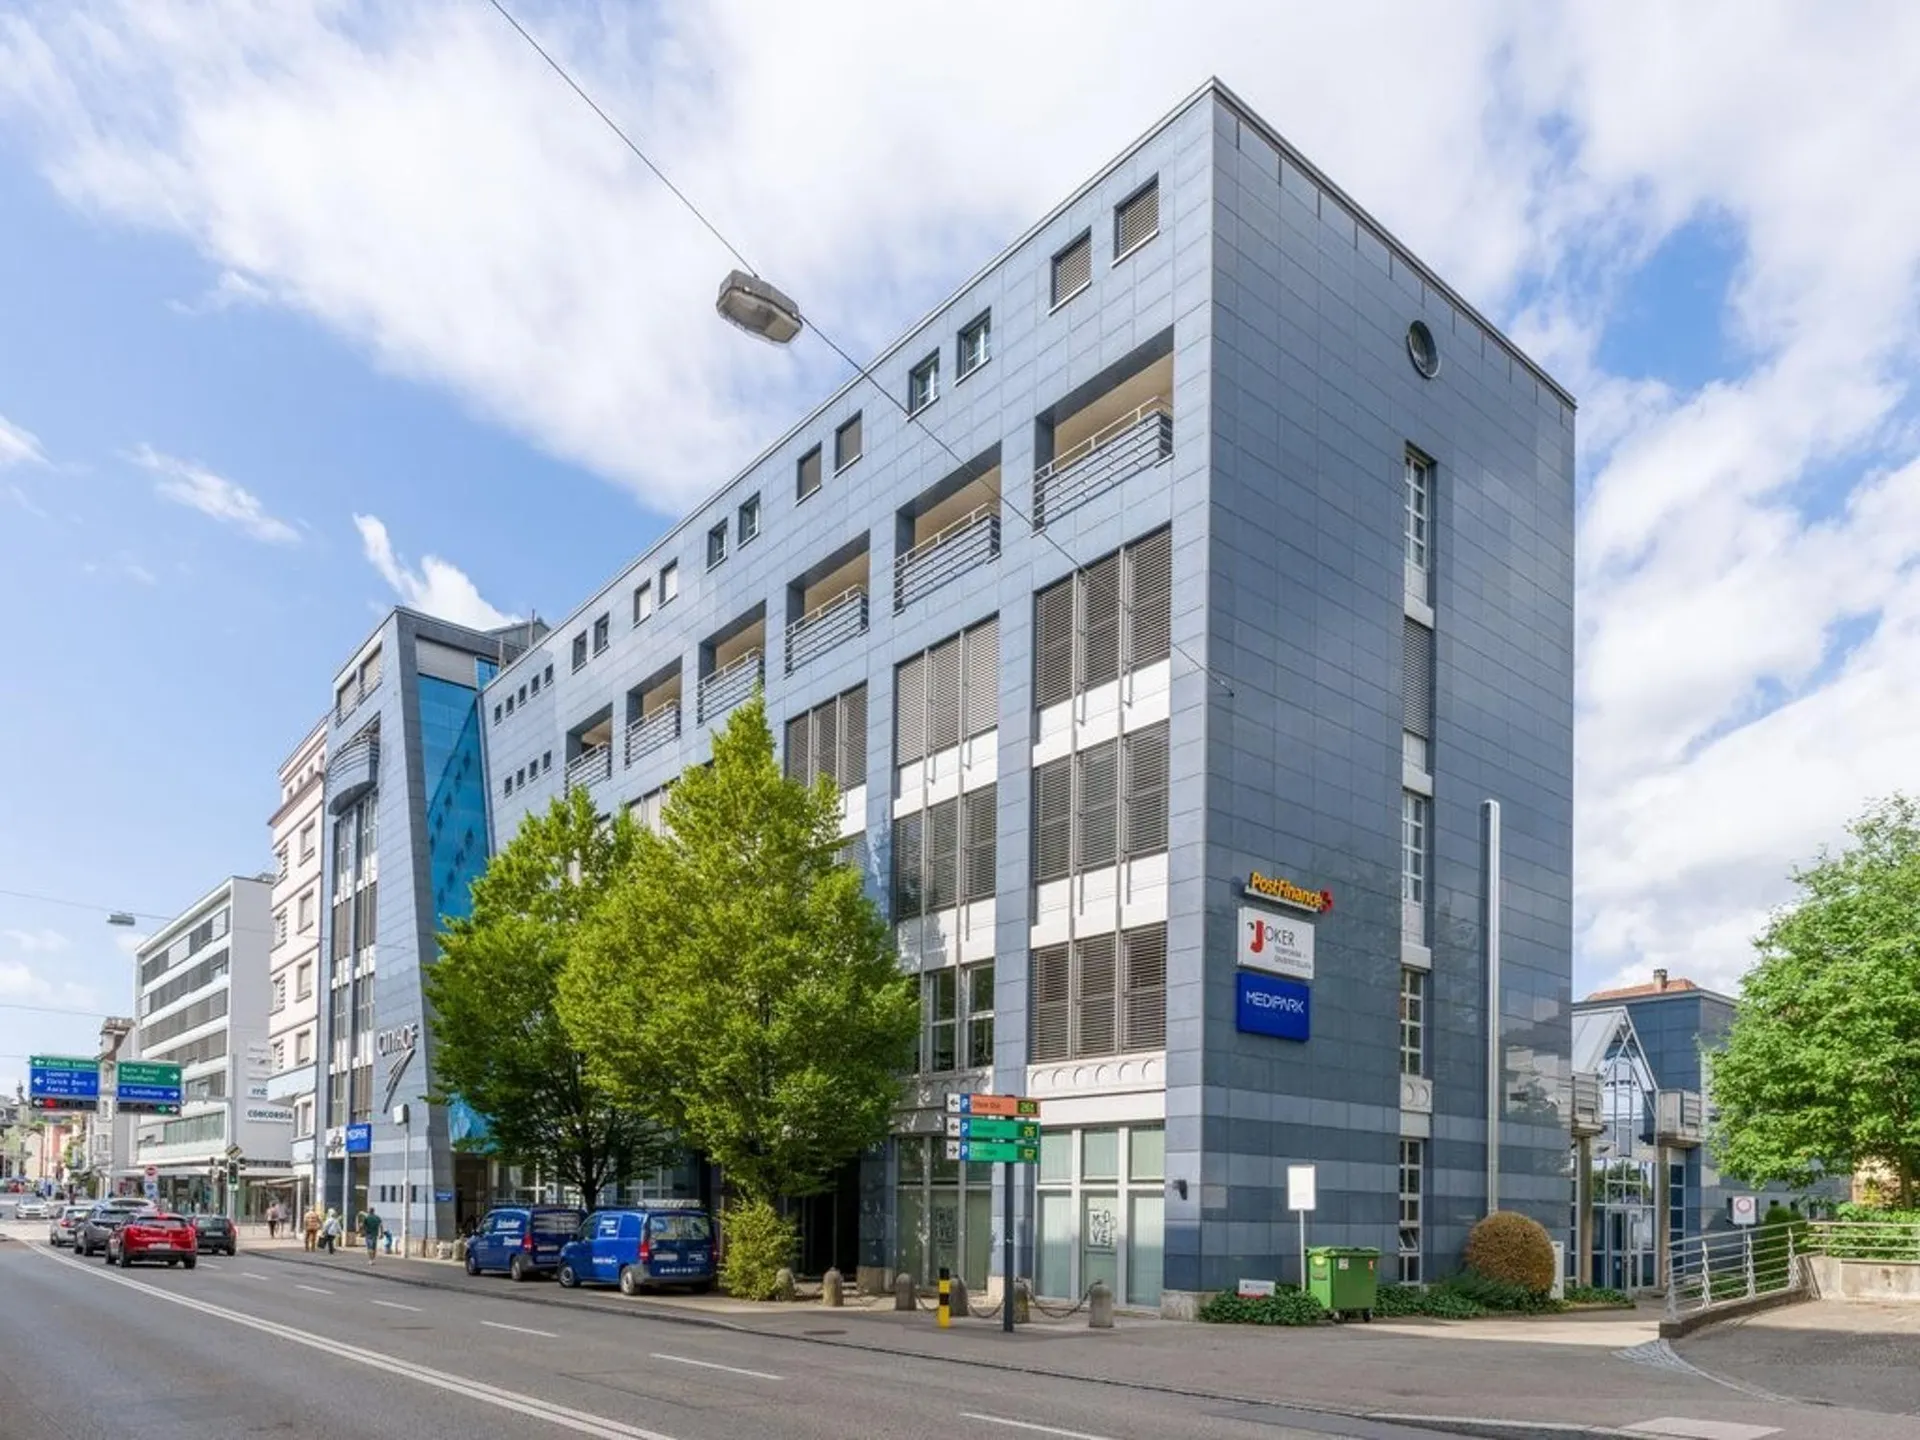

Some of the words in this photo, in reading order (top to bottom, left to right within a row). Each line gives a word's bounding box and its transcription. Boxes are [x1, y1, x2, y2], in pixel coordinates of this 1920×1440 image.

[1251, 871, 1323, 908] PostFinance
[1250, 920, 1295, 953] JOKER
[1245, 990, 1305, 1014] MEDIPARK
